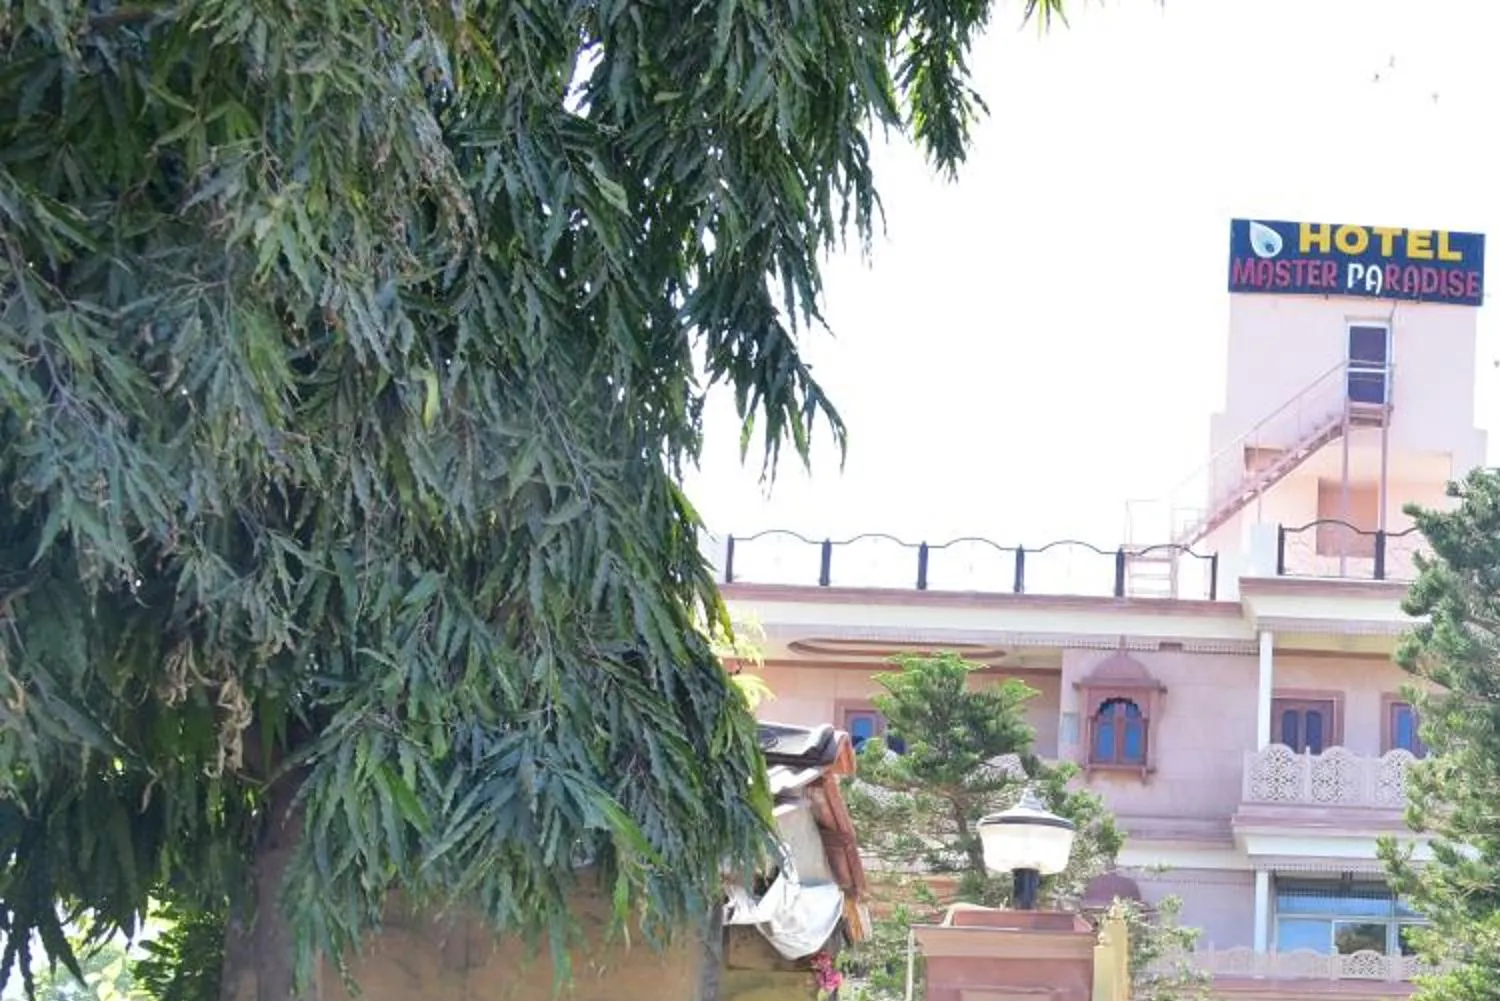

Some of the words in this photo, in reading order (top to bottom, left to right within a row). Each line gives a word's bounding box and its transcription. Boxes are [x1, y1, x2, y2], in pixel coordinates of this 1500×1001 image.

[1300, 223, 1463, 261] HOTEL
[1232, 257, 1338, 289] MASTER
[1347, 262, 1480, 297] PARADISE
